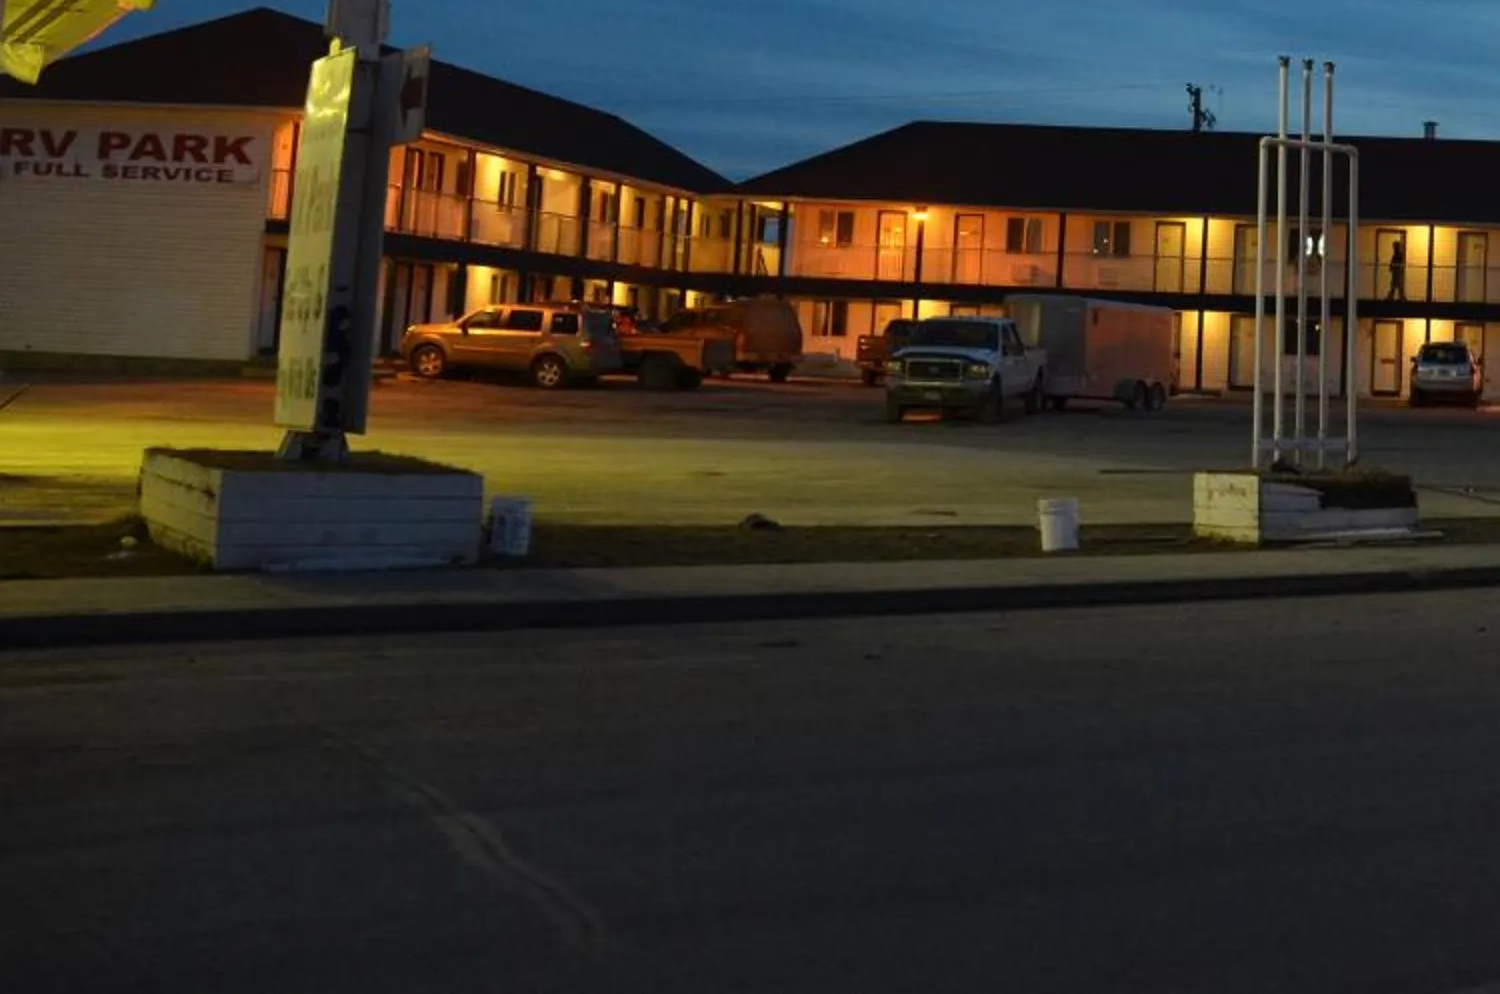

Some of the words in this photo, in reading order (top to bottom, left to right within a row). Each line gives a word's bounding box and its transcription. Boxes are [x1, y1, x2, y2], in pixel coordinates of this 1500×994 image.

[0, 127, 77, 158] RV
[97, 131, 255, 165] PARK
[13, 161, 90, 178] FULL
[100, 163, 234, 183] SERVICE
